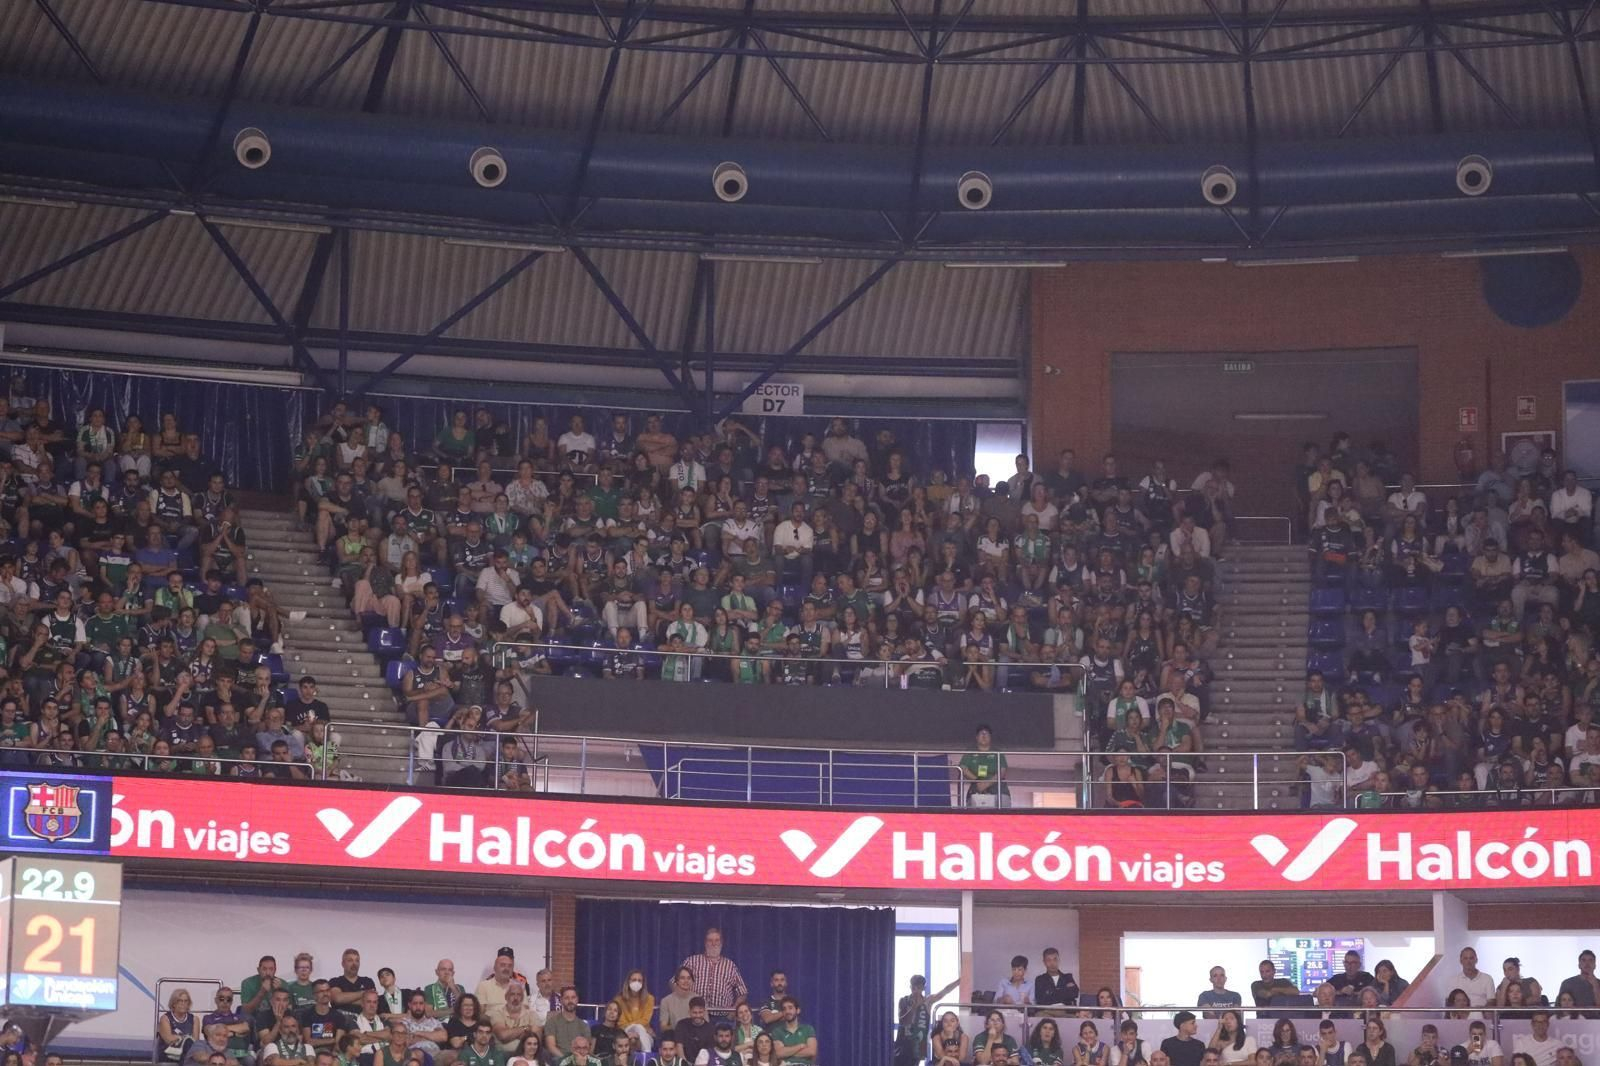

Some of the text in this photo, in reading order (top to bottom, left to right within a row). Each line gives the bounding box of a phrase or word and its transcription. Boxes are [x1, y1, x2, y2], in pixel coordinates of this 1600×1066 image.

[756, 384, 800, 397] ECTOR
[763, 399, 785, 412] D7
[42, 807, 64, 815] FCB
[184, 820, 291, 859] viajes
[430, 813, 756, 880] Halcón viajes
[1367, 827, 1592, 881] Halcón
[892, 831, 1226, 889] Halcón viajes
[22, 867, 95, 899] 22.9
[24, 914, 96, 975] 21
